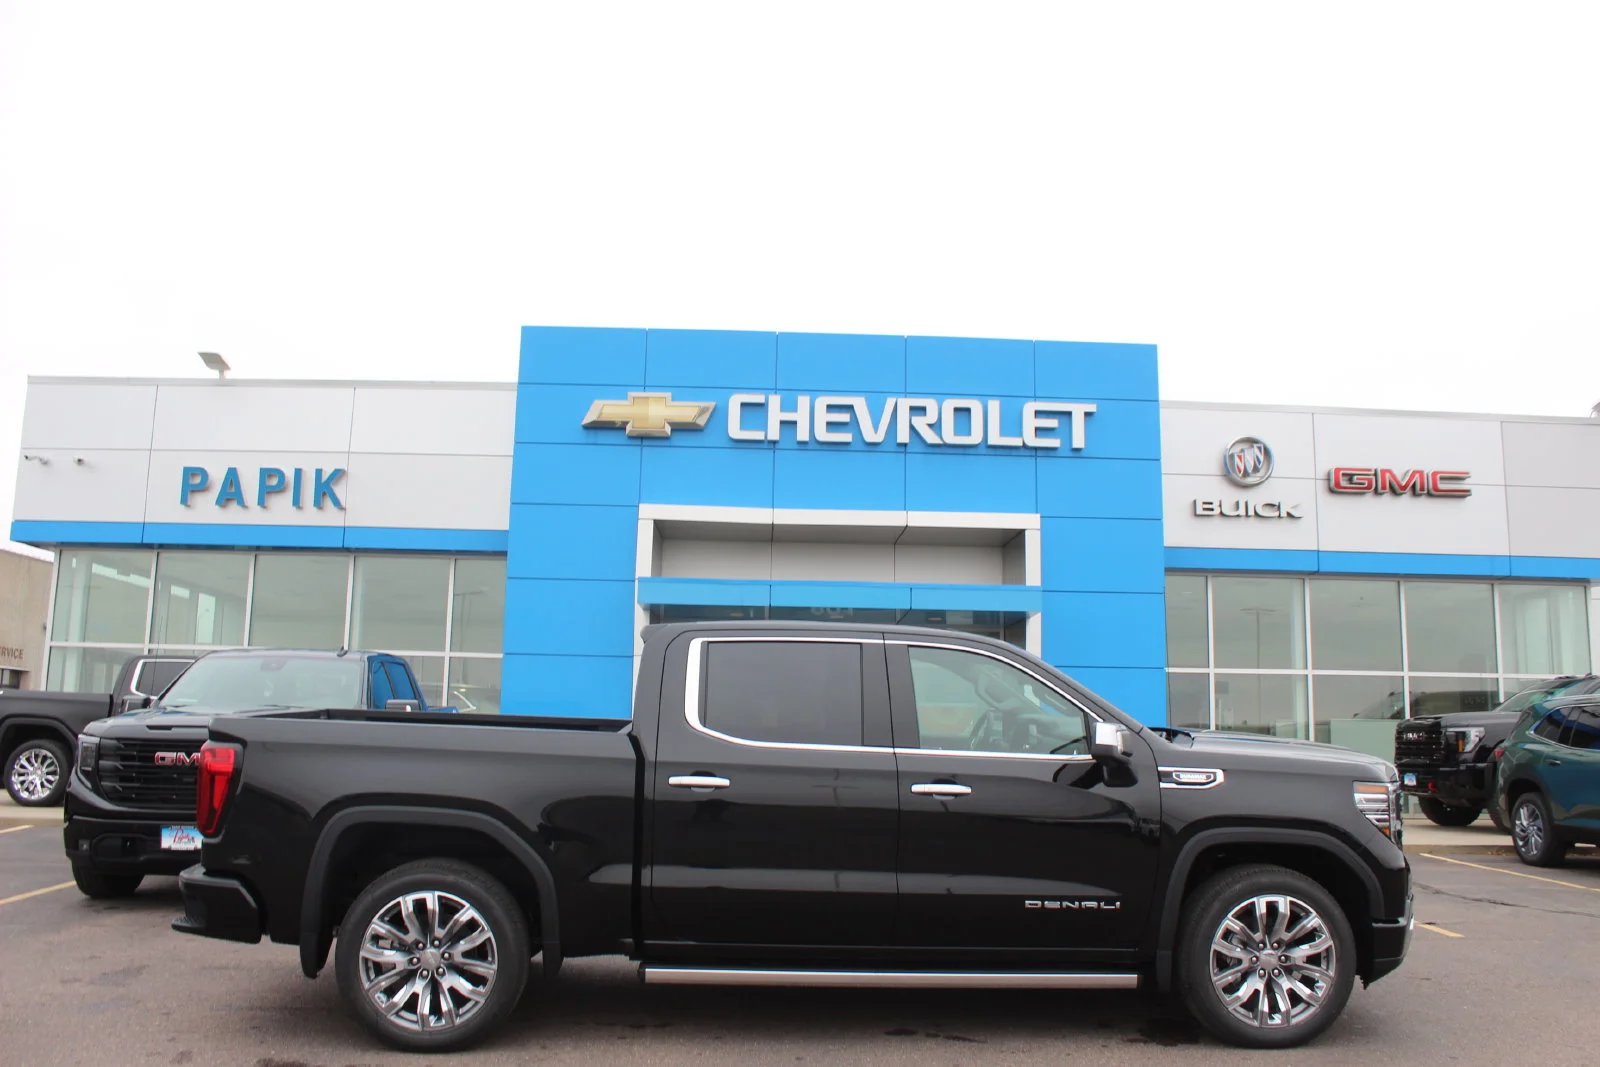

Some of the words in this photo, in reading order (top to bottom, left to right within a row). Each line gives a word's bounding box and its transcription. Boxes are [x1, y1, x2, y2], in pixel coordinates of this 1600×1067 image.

[727, 393, 1097, 450] CHEVROLET
[180, 466, 346, 511] PAPIK
[1329, 466, 1473, 498] GMC
[1194, 498, 1303, 519] BUICK
[154, 751, 201, 766] GM
[1024, 900, 1121, 910] DENALI
